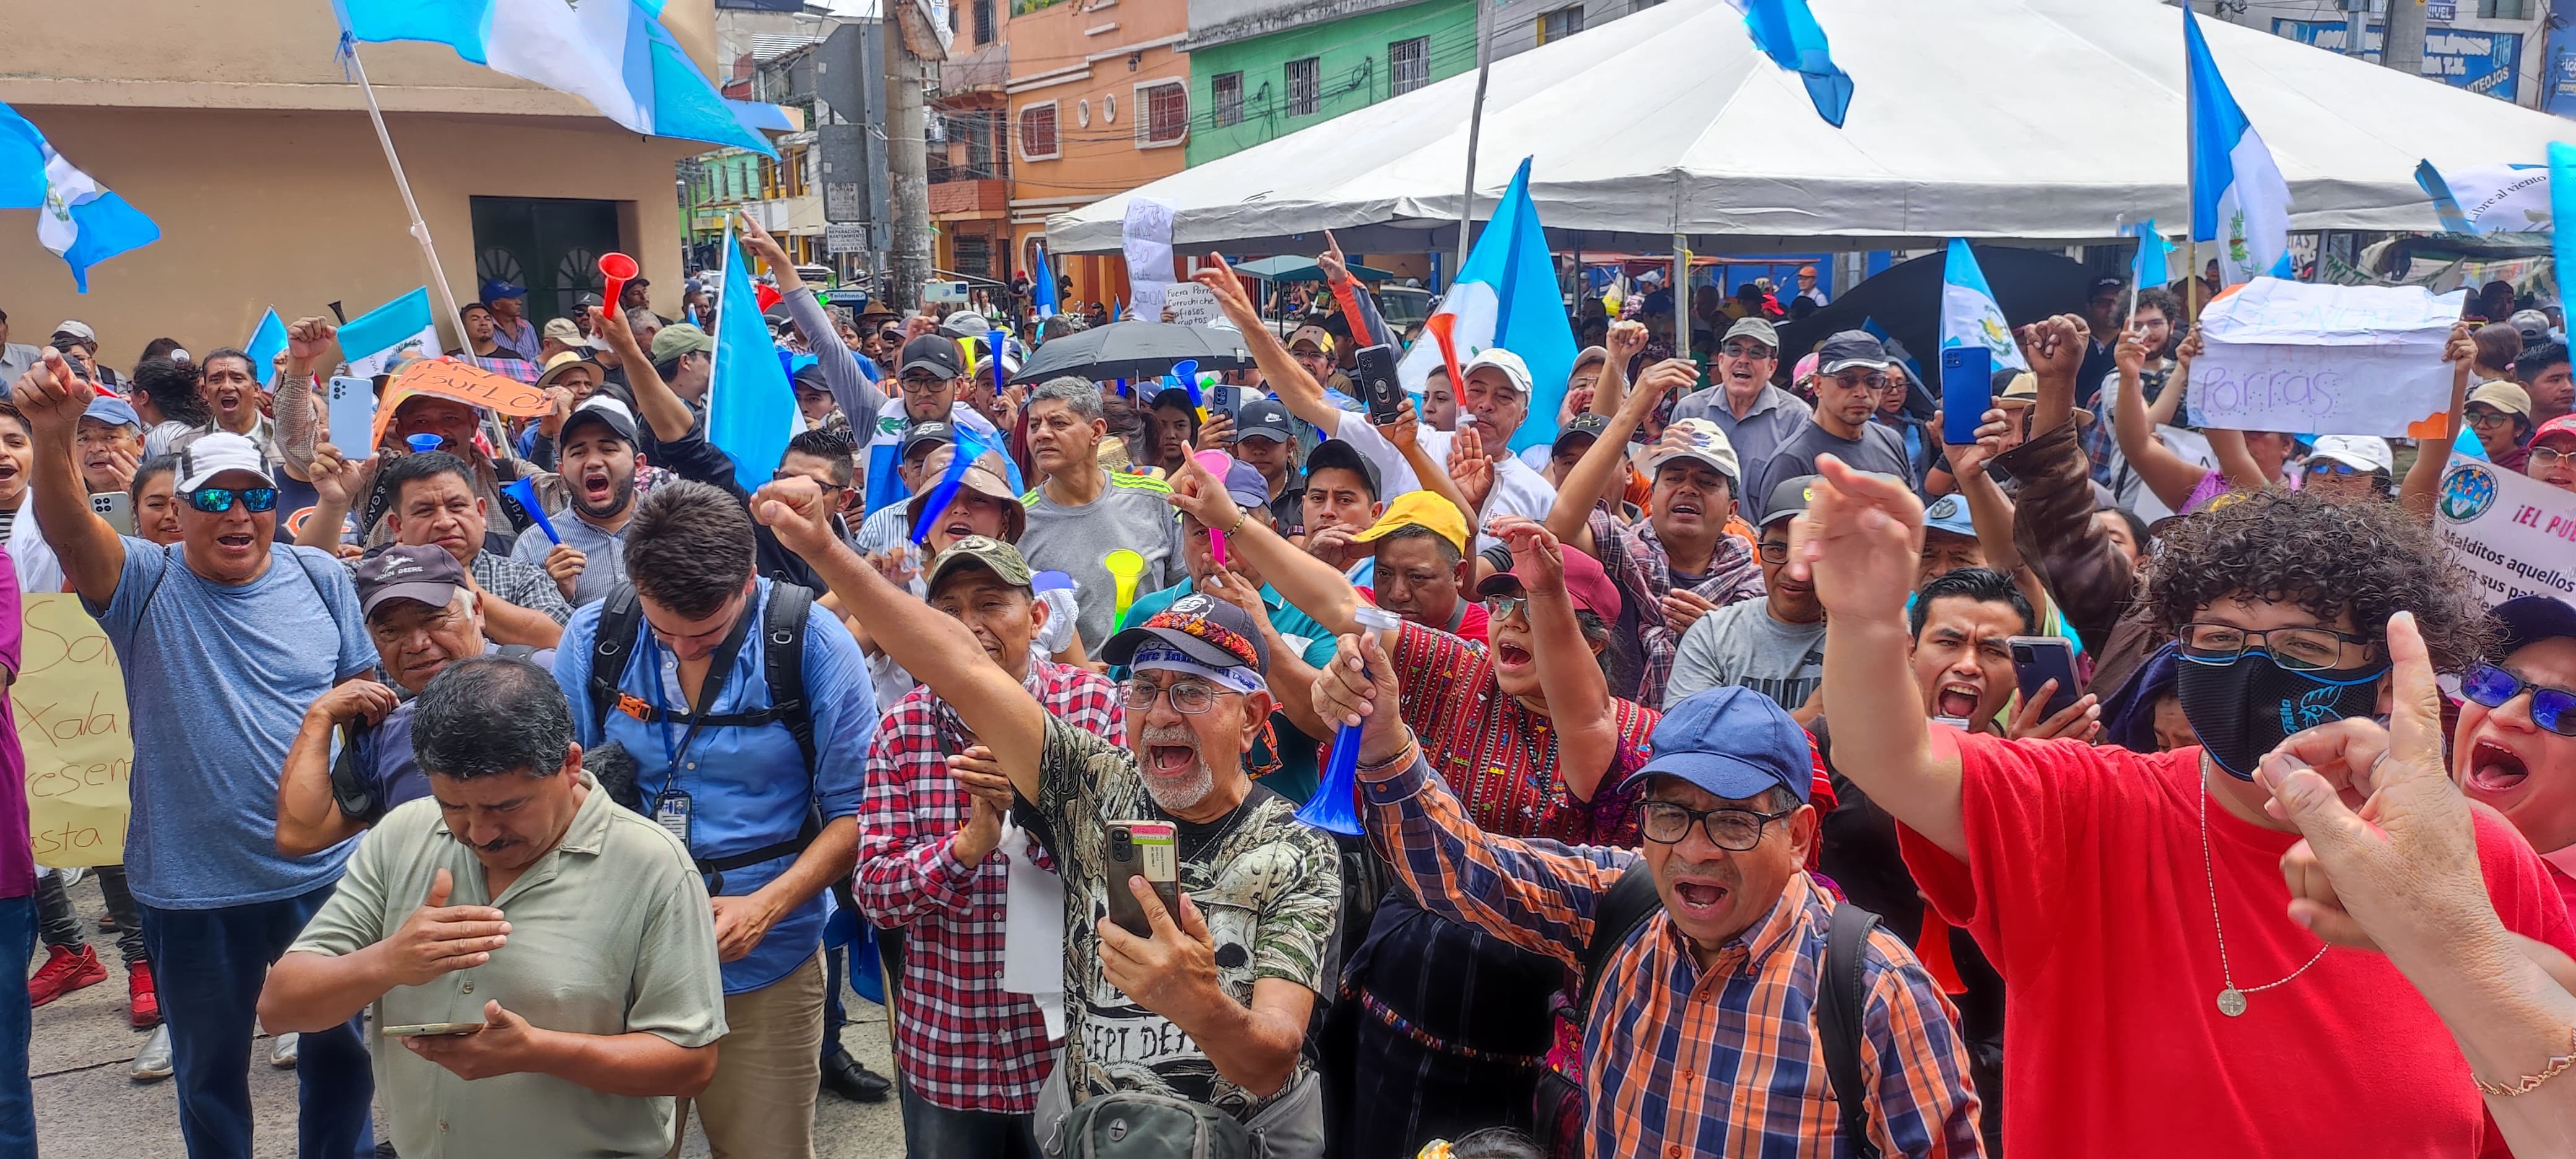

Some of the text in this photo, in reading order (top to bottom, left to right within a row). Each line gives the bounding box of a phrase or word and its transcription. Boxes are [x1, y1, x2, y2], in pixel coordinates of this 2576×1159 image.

[2463, 66, 2509, 93] NTEOJOS
[2466, 175, 2547, 224] Libre al viento
[1167, 289, 1188, 297] Fuera
[1168, 297, 1214, 306] Curruchiche
[1173, 308, 1204, 319] afiosos
[2201, 367, 2338, 415] Porras
[2512, 505, 2542, 529] ¡EL
[2444, 529, 2576, 593] Malditos aquellos
[375, 566, 424, 581] JOHN DEERE
[2481, 575, 2506, 593] sus
